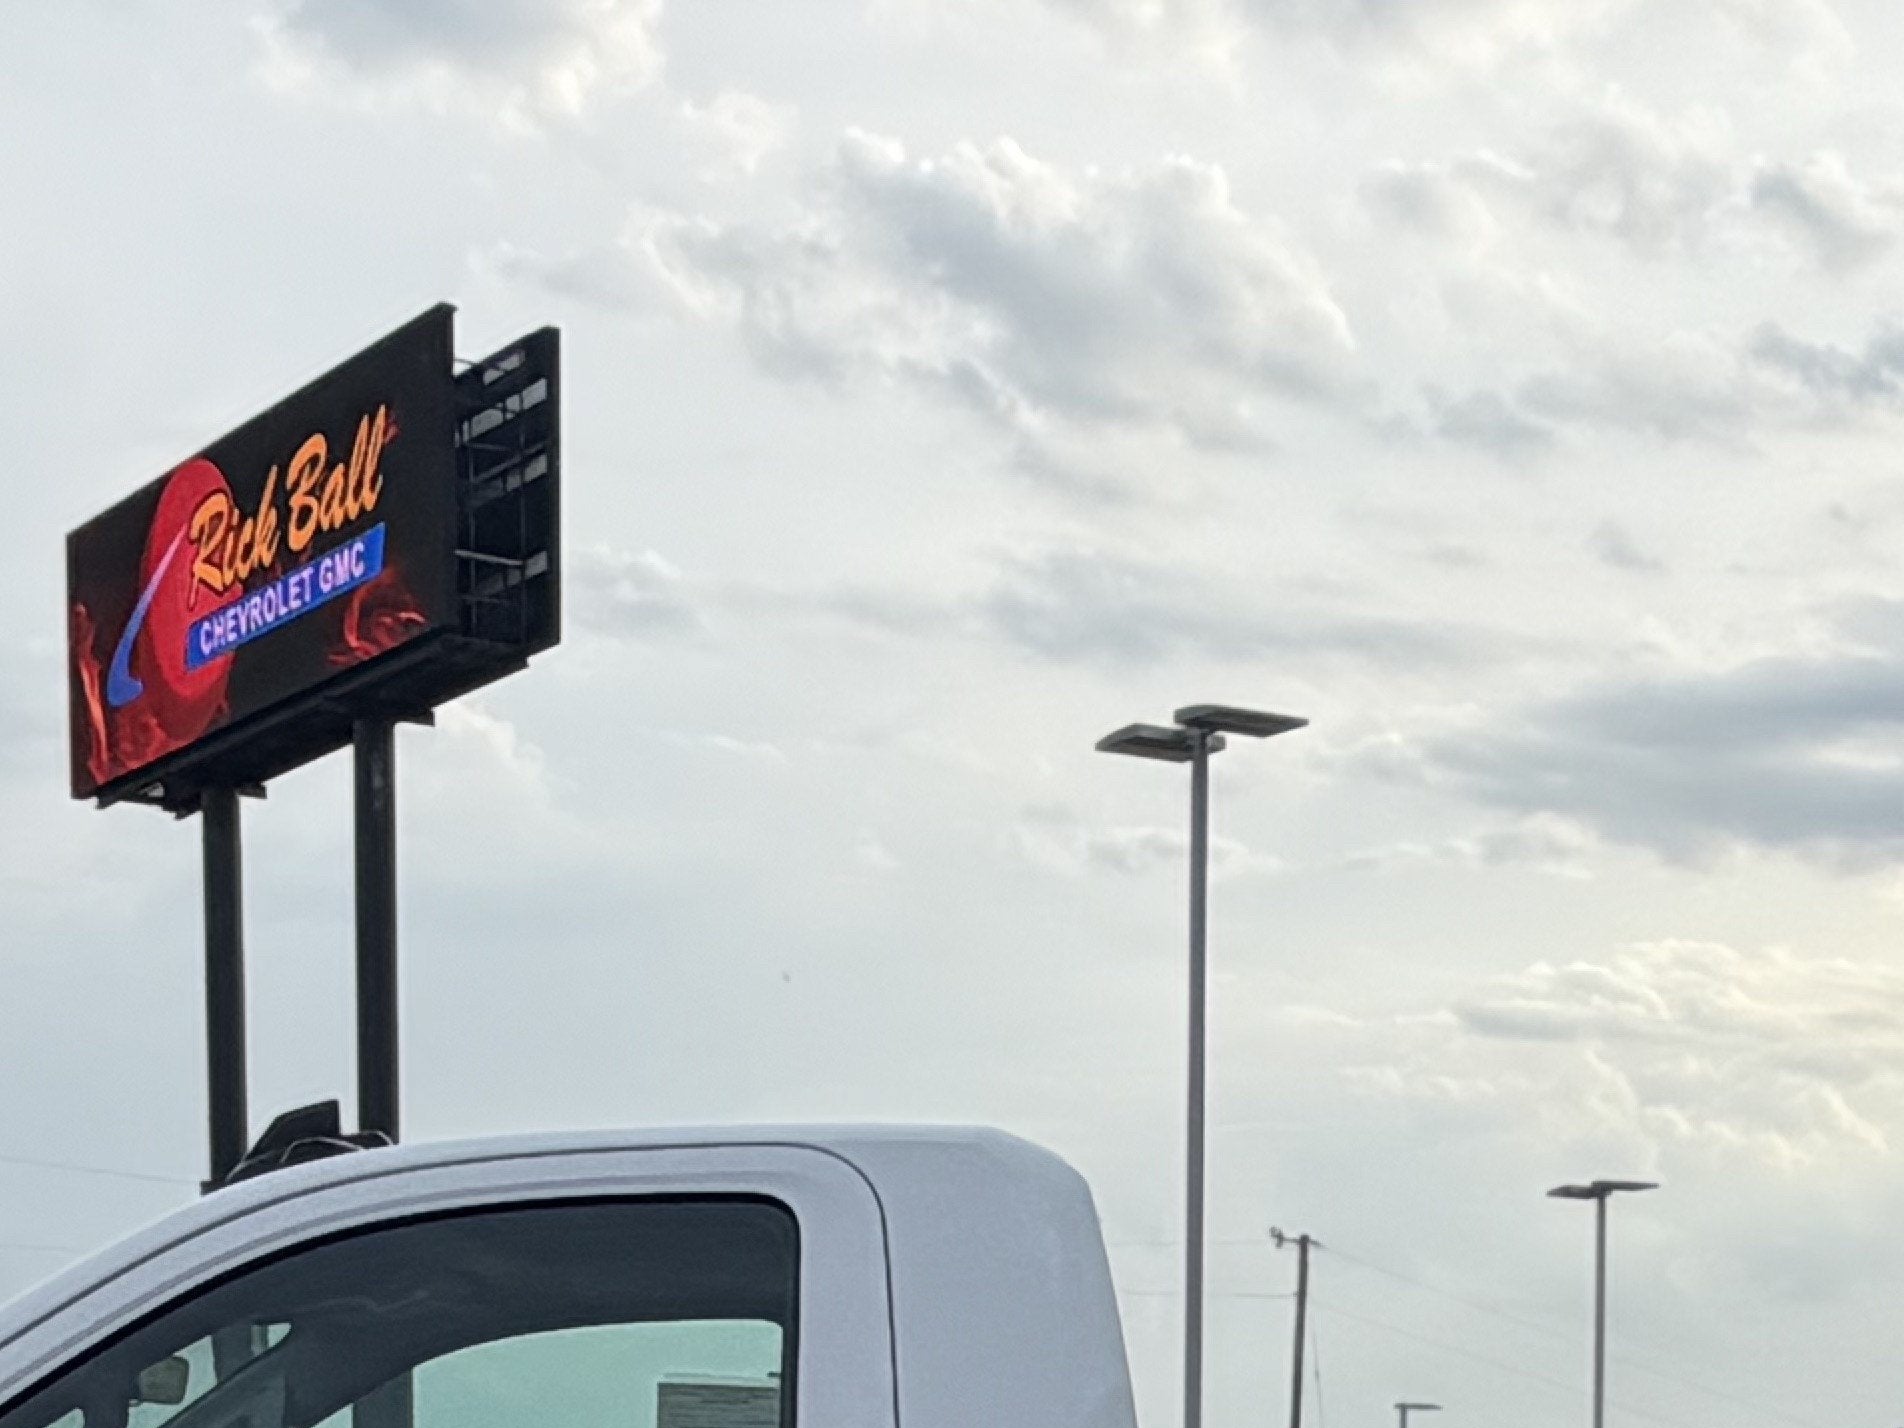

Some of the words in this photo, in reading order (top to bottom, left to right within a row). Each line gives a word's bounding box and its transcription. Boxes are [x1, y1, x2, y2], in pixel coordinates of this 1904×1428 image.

[187, 464, 281, 608] Rick
[286, 402, 386, 552] Ball
[199, 567, 314, 656] CHEVROLET
[318, 541, 366, 593] GMC
